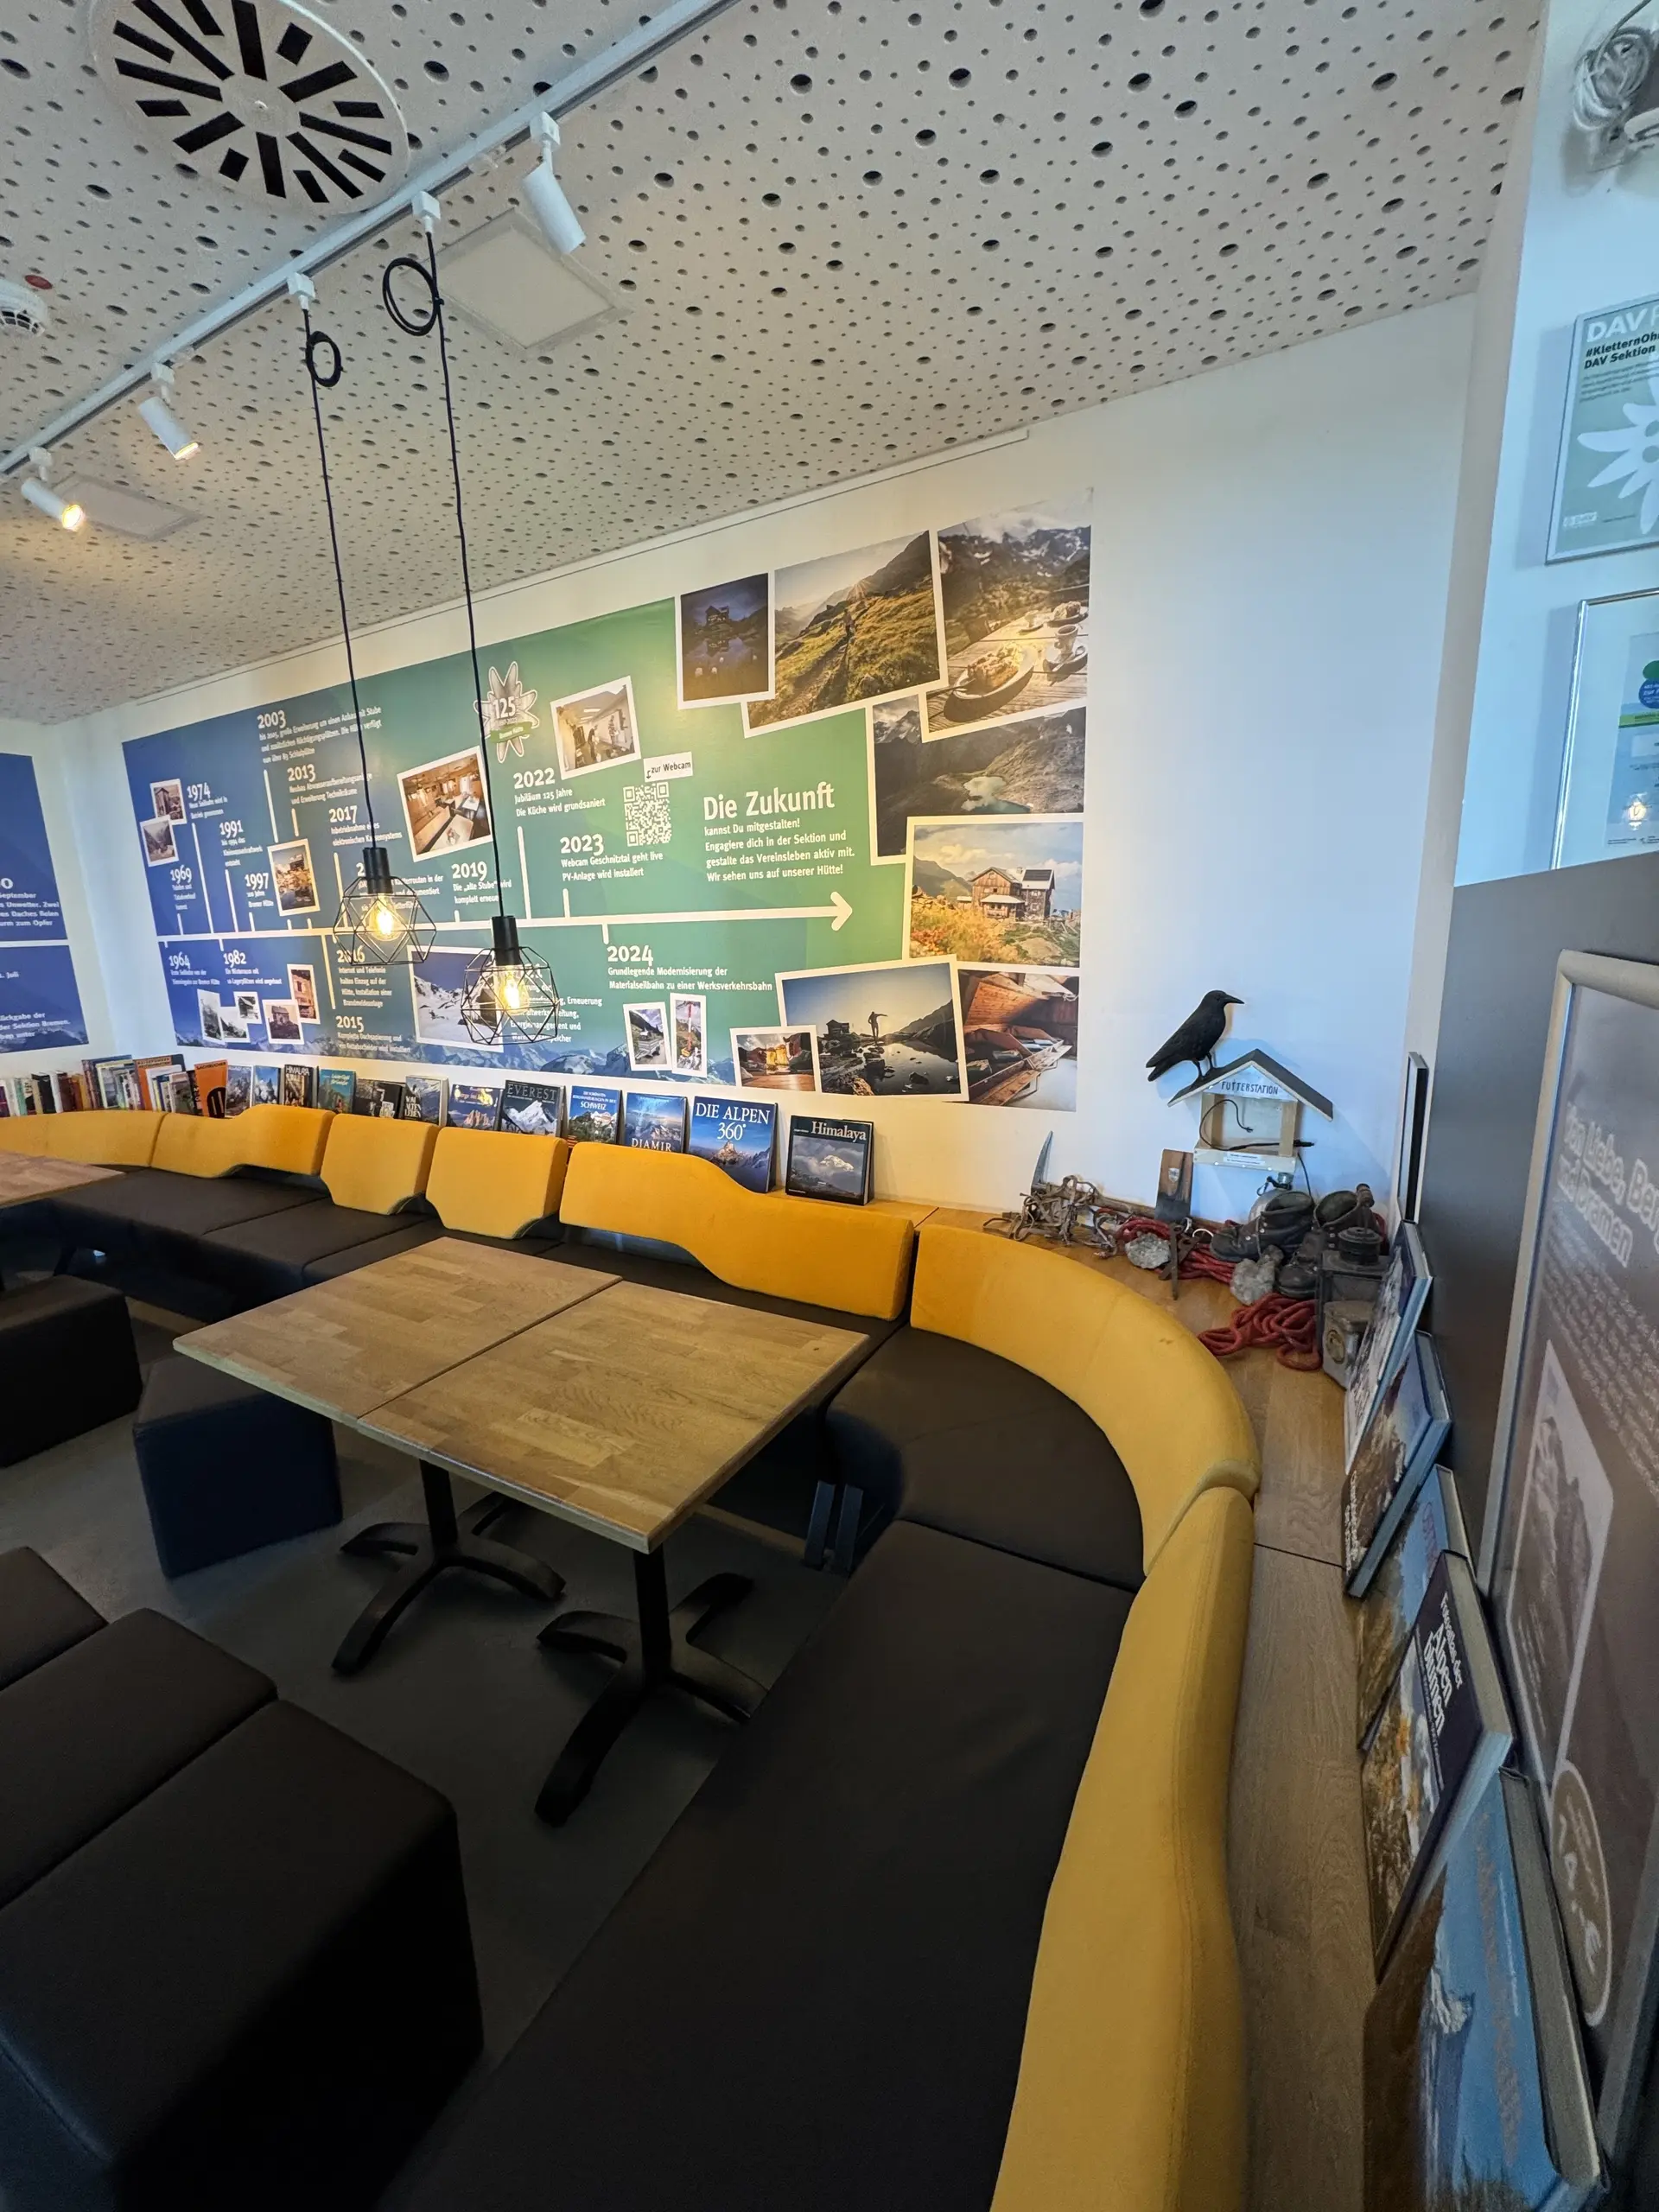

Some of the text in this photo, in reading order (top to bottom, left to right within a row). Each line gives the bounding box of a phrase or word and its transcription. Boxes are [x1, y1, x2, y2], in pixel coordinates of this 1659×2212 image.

[1586, 308, 1648, 343] DAV
[1584, 345, 1656, 370] DAV Sektion
[492, 695, 518, 721] 125
[257, 709, 287, 729] 2003
[287, 764, 316, 783] 2013
[651, 760, 691, 773] zur Webcam
[513, 767, 556, 790] 2022
[187, 782, 211, 802] 1974
[514, 787, 573, 805] Jubiläum 125 Jahre
[703, 781, 836, 821] Die Zukunft
[328, 805, 358, 823] 2017
[516, 798, 606, 817] Die Küche wird grundsaniert
[219, 820, 244, 838] 1991
[704, 817, 800, 836] kannst Du mitgestalten!
[560, 834, 605, 856] 2023
[705, 830, 847, 853] Engagiere dich in der Sektion und
[561, 850, 664, 868] Webcam Geschnitztal geht live
[706, 847, 855, 869] gestalte das Vereinsleben aktiv mit.
[169, 865, 193, 885] 1969
[435, 874, 444, 883] der
[452, 861, 488, 881] 2019
[563, 867, 645, 882] PV-Anlage wird installiert
[707, 864, 843, 882] Wir sehen uns auf unserer Hütte!
[245, 873, 270, 891] 1997
[453, 882, 463, 893] Die
[454, 894, 479, 906] komplett
[168, 951, 191, 969] 1964
[223, 950, 247, 968] 1982
[607, 944, 654, 966] 2024
[607, 966, 728, 978] Grundlegende Modernisierung der
[609, 980, 664, 991] Materialseilbahn
[677, 981, 696, 990] einer
[697, 980, 772, 991] Werksverkehrsbahn
[567, 996, 602, 1007] Erneuerung
[336, 1015, 364, 1033] 2015
[506, 1084, 556, 1102] EVEREST
[1221, 1080, 1279, 1096] FUTTERSTATION
[580, 1101, 607, 1110] SCHWEIZ
[696, 1103, 771, 1125] DIE ALPEN
[716, 1122, 747, 1141] 360°
[810, 1121, 867, 1143] Himalaya
[631, 1137, 671, 1153] DIAMIR
[1433, 1623, 1452, 1708] Alpen
[1424, 1630, 1446, 1738] blumen
